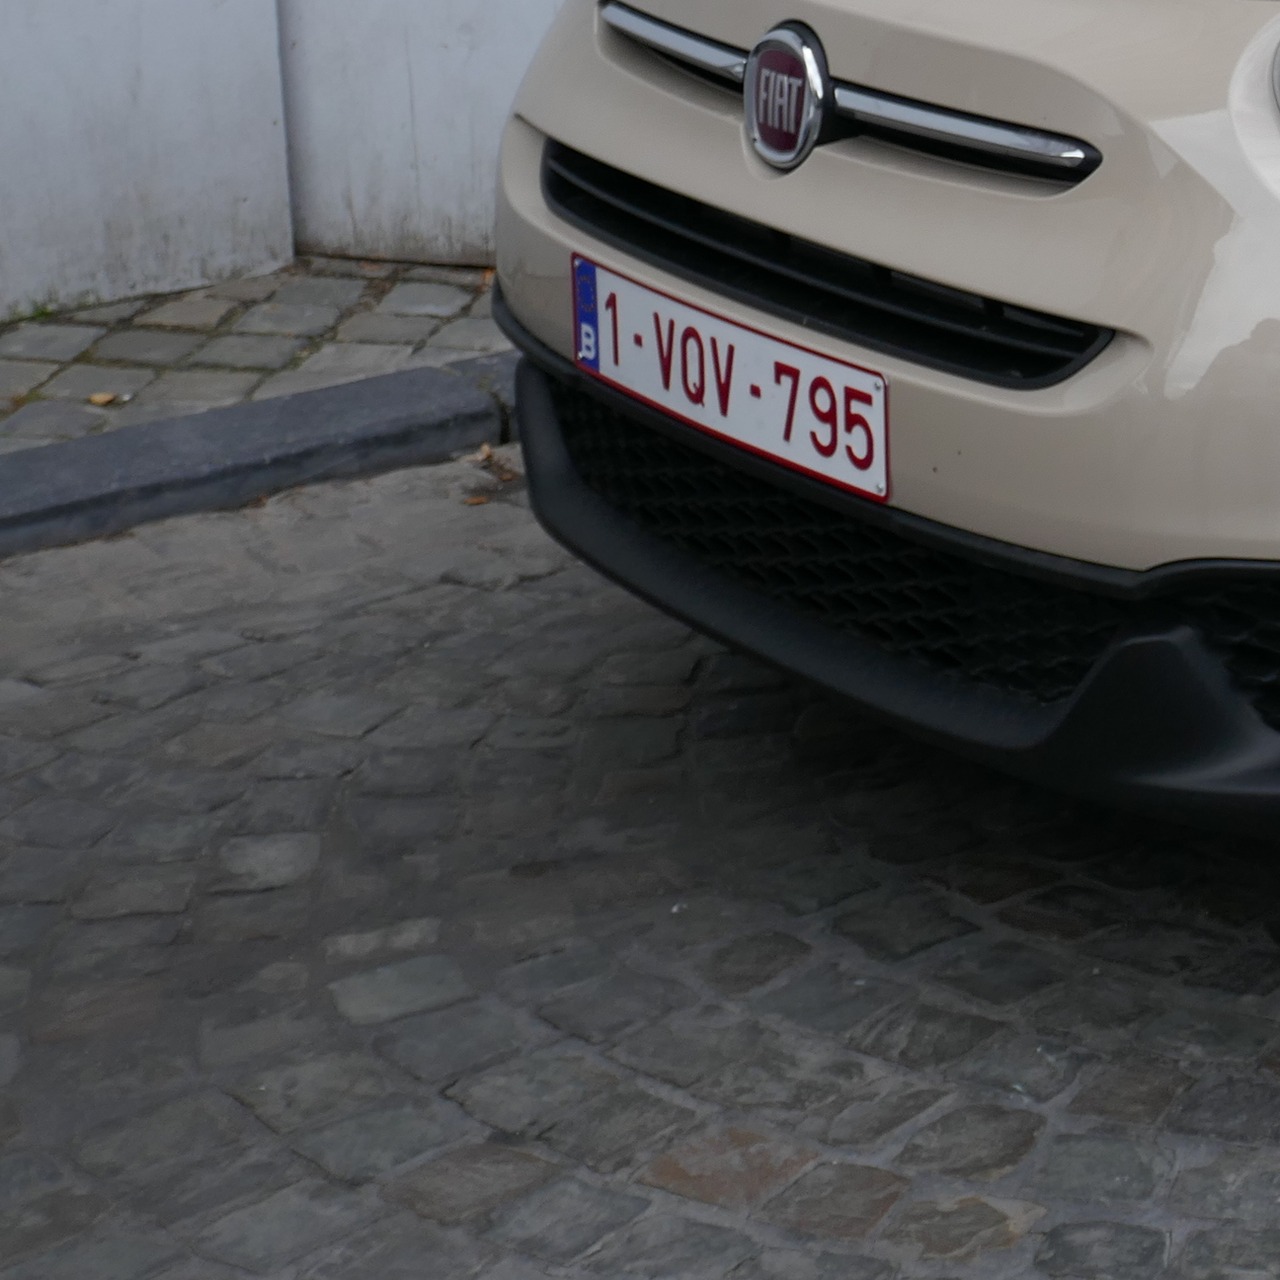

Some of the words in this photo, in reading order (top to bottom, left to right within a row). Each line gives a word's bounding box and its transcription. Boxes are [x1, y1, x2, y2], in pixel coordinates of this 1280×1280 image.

[758, 68, 802, 135] FIAT
[580, 323, 597, 361] B
[604, 292, 874, 471] 1-VQV-795
